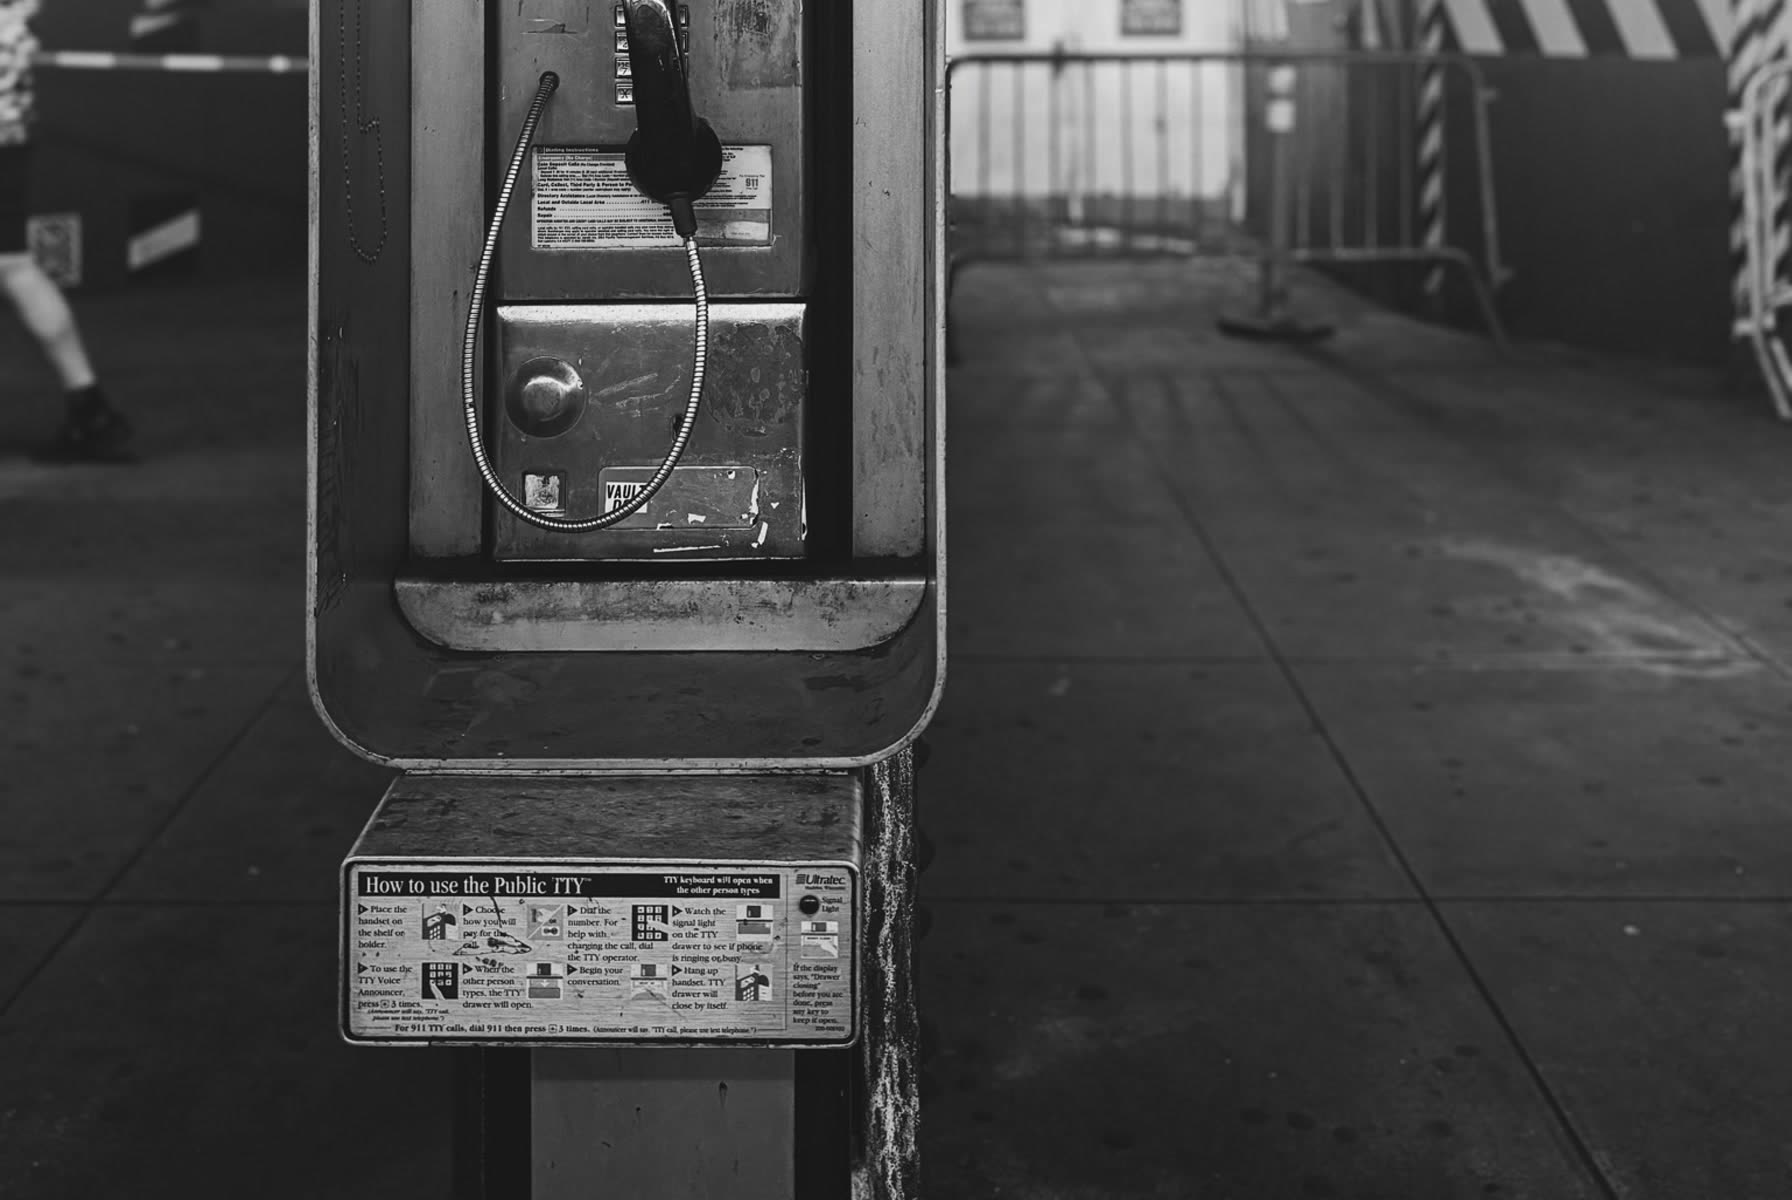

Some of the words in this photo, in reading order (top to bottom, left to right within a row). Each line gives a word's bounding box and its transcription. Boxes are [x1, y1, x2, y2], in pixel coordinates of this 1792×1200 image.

[746, 178, 758, 187] 911
[680, 876, 715, 885] keyboard
[805, 874, 845, 885] Ultratec
[367, 877, 403, 893] How
[409, 879, 424, 893] to
[430, 881, 458, 893] use
[464, 876, 489, 894] the
[495, 876, 546, 894] Public
[713, 885, 740, 896] person
[740, 888, 760, 896] types
[713, 908, 726, 916] the
[358, 917, 390, 925] handset
[672, 919, 696, 928] signal
[697, 919, 716, 928] light
[358, 929, 372, 937] the
[568, 930, 586, 940] help
[685, 930, 699, 938] the
[700, 930, 718, 939] TTY
[568, 942, 603, 951] charging
[736, 942, 764, 952] phone
[681, 954, 710, 963] ringing
[399, 965, 413, 974] the
[580, 966, 602, 975] Begin
[604, 968, 623, 976] your
[684, 967, 706, 976] Hang
[357, 976, 376, 984] TTY
[486, 977, 515, 986] person
[357, 1000, 379, 1010] press
[391, 1000, 396, 1008] 3
[672, 1002, 692, 1012] close
[694, 1002, 705, 1011] by
[446, 1024, 467, 1032] calls,
[524, 1026, 546, 1034] press
